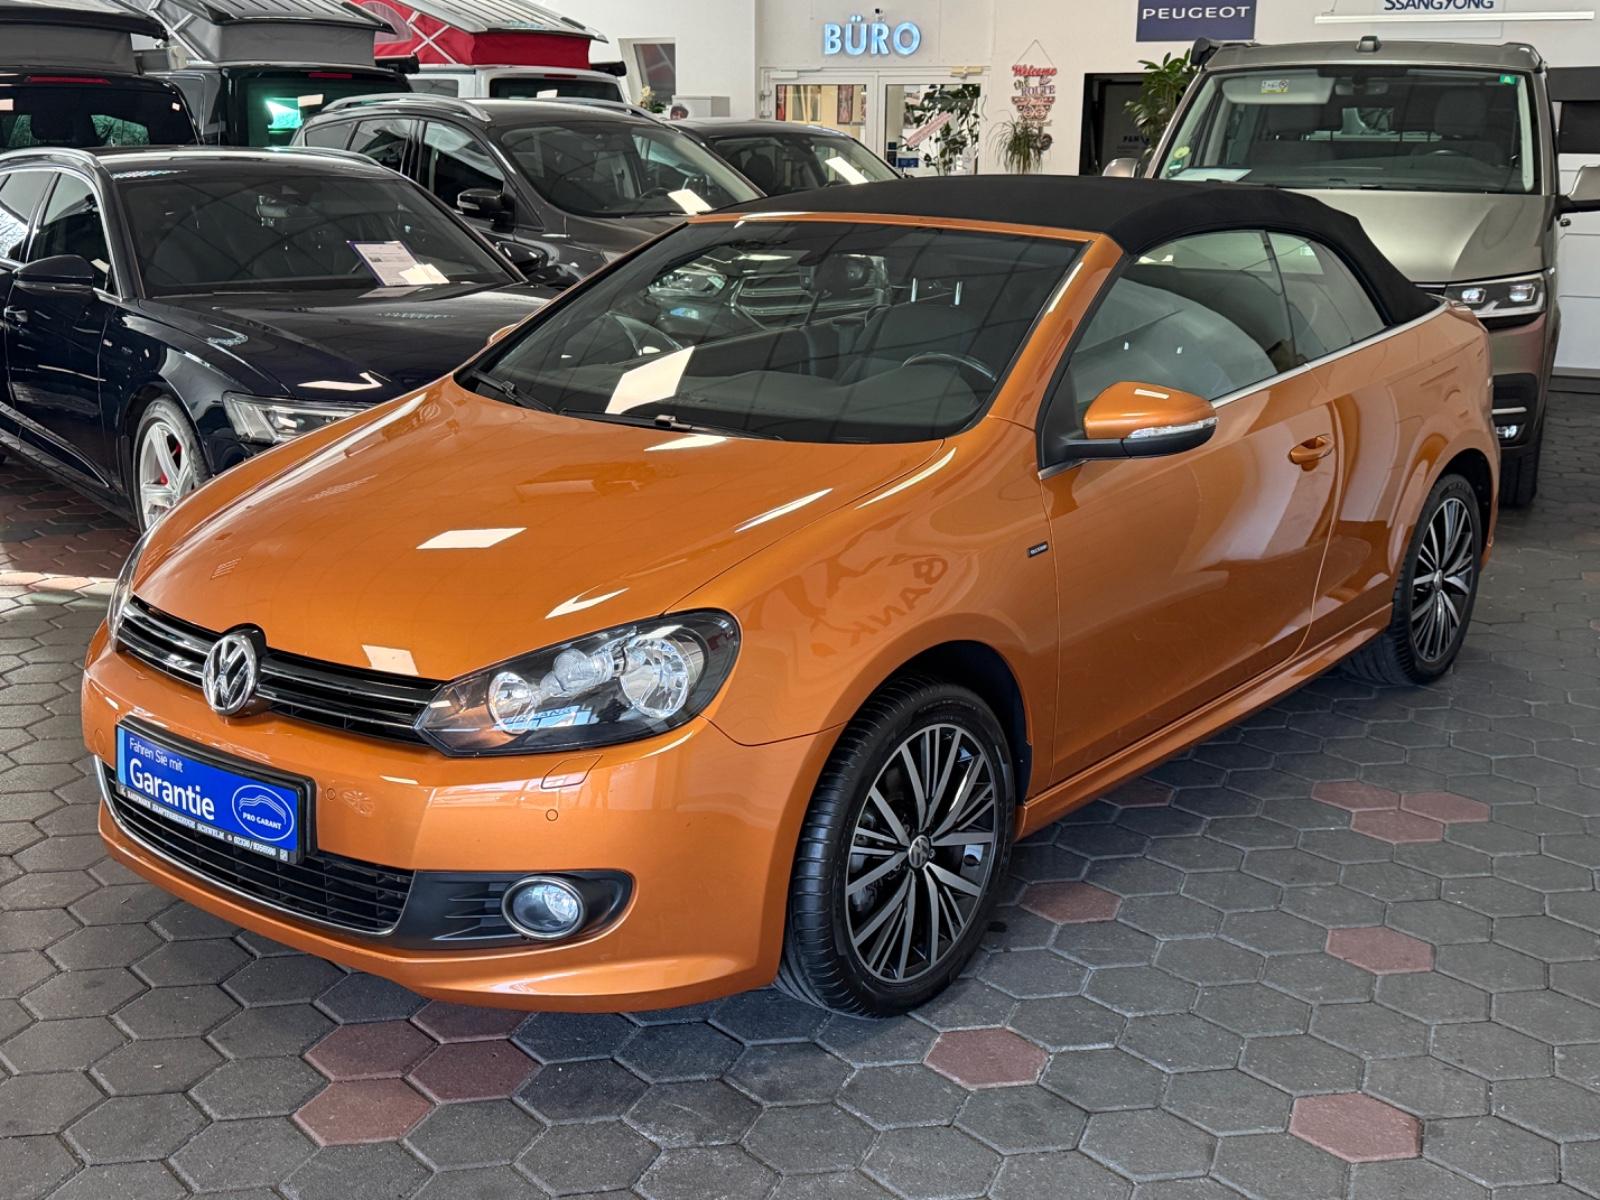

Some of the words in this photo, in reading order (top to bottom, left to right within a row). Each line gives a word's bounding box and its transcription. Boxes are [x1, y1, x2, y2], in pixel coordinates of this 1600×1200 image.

[1142, 6, 1250, 19] PEUGEOT
[824, 15, 921, 56] BÜRO
[130, 737, 154, 758] Fahren
[156, 750, 167, 767] Sie
[169, 758, 183, 773] mit
[130, 758, 215, 820] Garantie
[242, 812, 256, 822] PRO
[256, 816, 282, 830] GARANT
